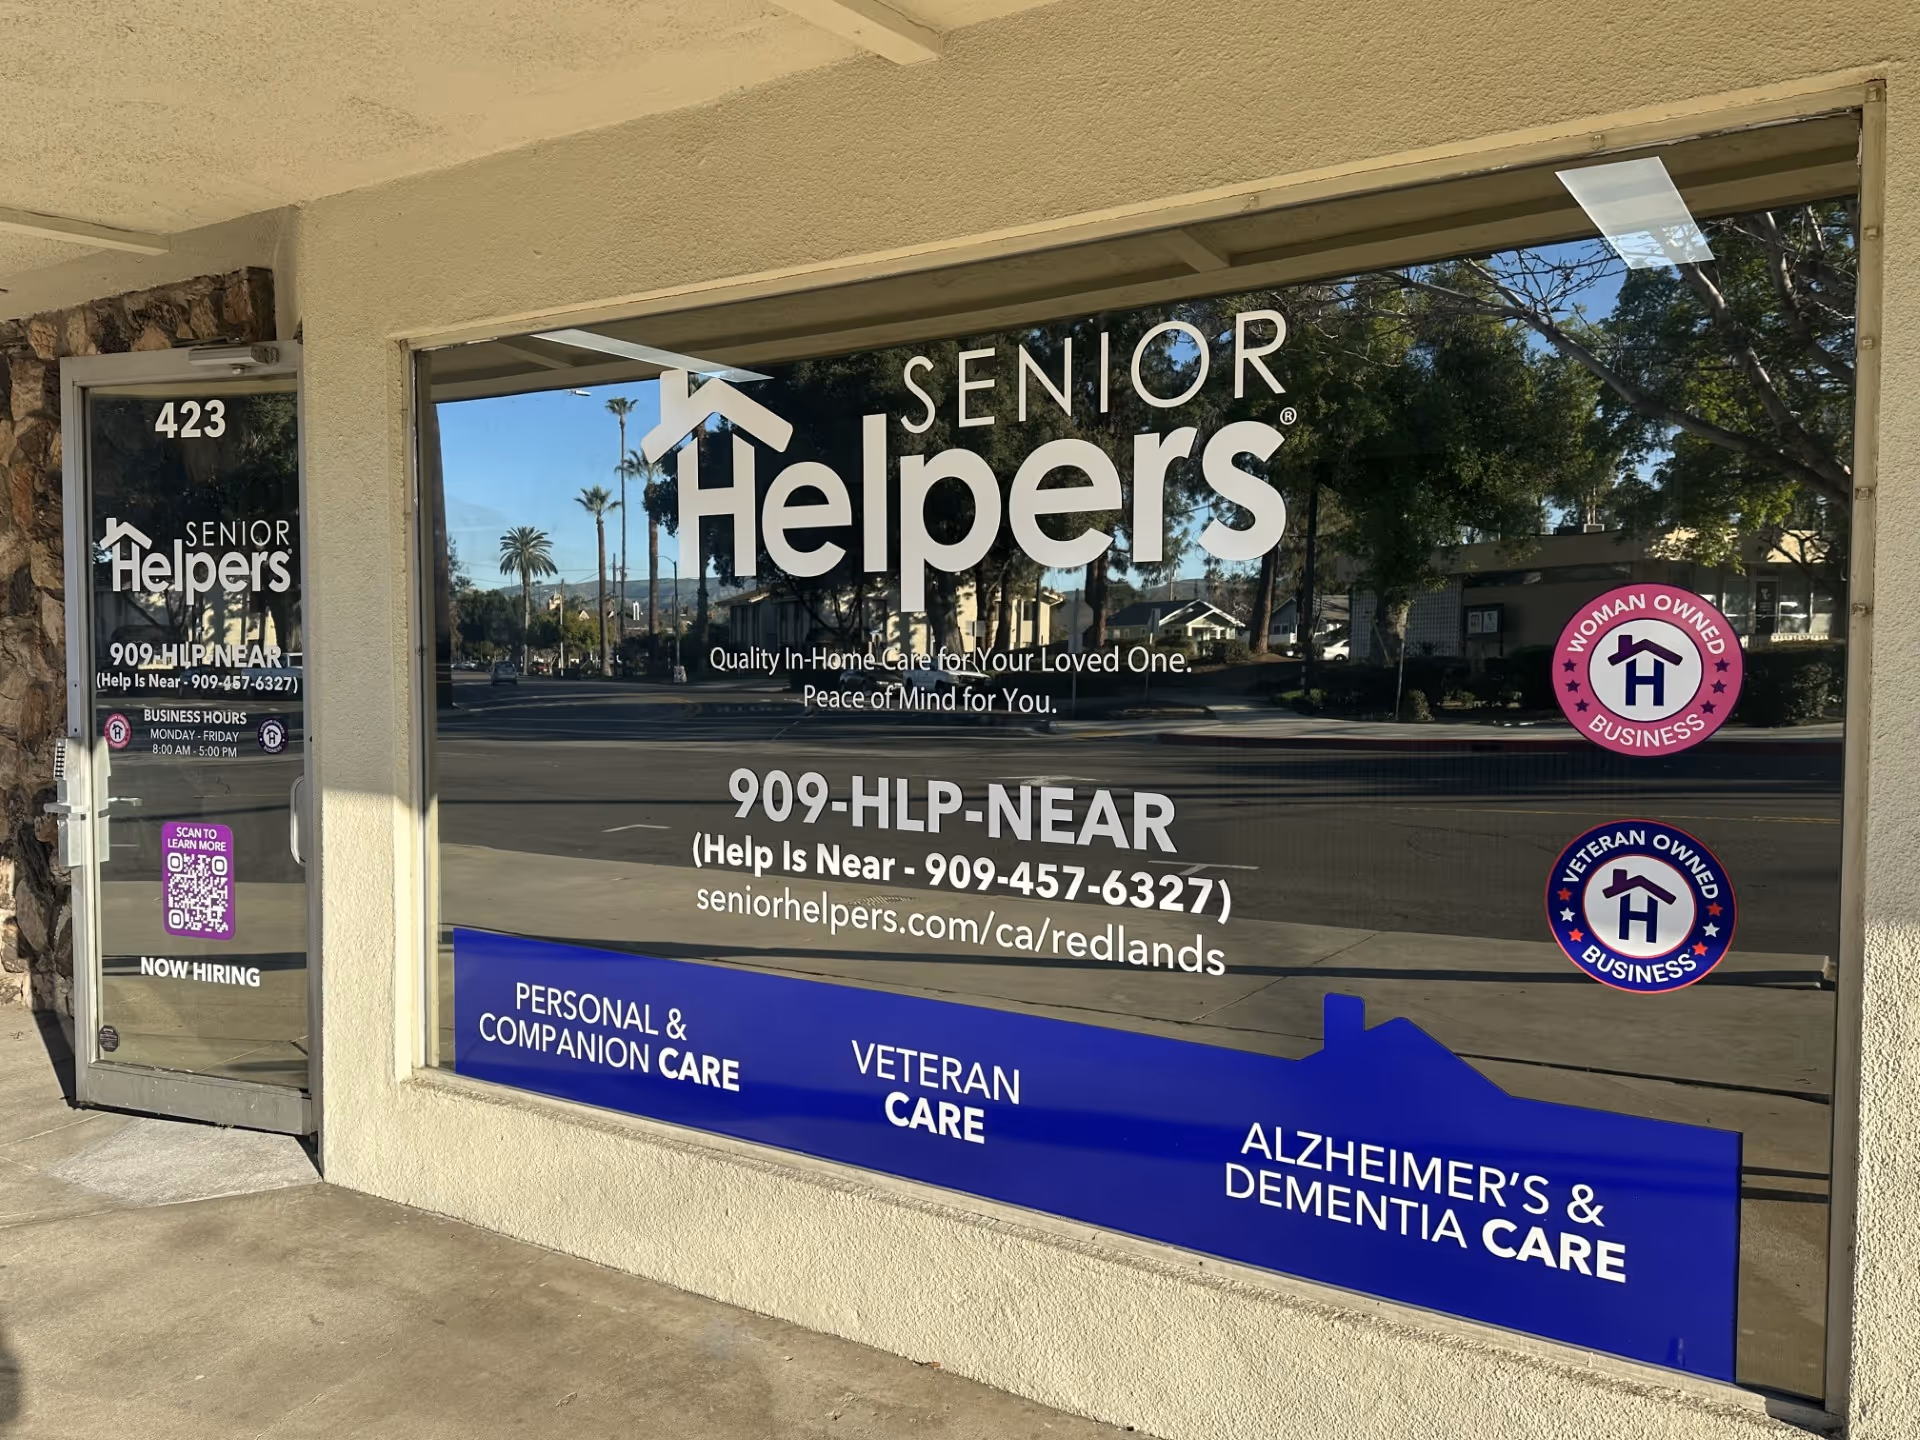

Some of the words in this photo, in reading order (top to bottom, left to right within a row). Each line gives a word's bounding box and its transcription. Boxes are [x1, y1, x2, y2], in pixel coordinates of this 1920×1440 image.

[901, 309, 1287, 434] SENIOR
[155, 399, 226, 438] 423
[185, 519, 290, 547] SENIOR
[1567, 593, 1646, 653] WOMAN
[1653, 594, 1726, 655] OWNED
[110, 642, 282, 668] 909-HLP-NEAR
[710, 646, 780, 675] Quality
[785, 647, 875, 671] In-Home
[882, 648, 932, 671] Care
[938, 646, 968, 671] for
[977, 647, 1034, 672] Your
[1041, 645, 1119, 673] Loved
[1127, 646, 1192, 673] One.
[96, 672, 131, 691] (Help
[135, 673, 145, 688] Is
[149, 674, 181, 689] Near
[191, 675, 299, 694] 909-457-6327)
[804, 684, 865, 708] Peace
[870, 685, 893, 709] of
[900, 685, 956, 711] Mind
[962, 686, 996, 712] for
[1002, 687, 1057, 714] You.
[144, 709, 200, 724] BUSINESS
[203, 711, 248, 725] HOURS
[150, 728, 195, 741] MONDAY
[203, 731, 239, 743] FRIDAY
[1588, 713, 1706, 748] BUSINESS
[152, 744, 173, 755] 8:00
[175, 745, 191, 756] AM
[199, 746, 220, 757] 5:00
[222, 747, 237, 758] PM
[728, 767, 1178, 853] 909-HLP-NEAR
[168, 838, 197, 850] LEARN
[199, 840, 227, 852] MORE
[176, 827, 202, 838] SCAN
[203, 828, 217, 840] TO
[692, 831, 773, 877] (Help
[783, 839, 807, 872] Is
[817, 842, 895, 881] Near
[925, 852, 1231, 924] 909-457-6327)
[1562, 830, 1646, 884] VETERAN
[1652, 834, 1719, 899] OWNED
[696, 885, 1226, 977] seniorhelpers.com/ca/redlands
[141, 957, 188, 980] NOW
[193, 962, 261, 988] HIRING
[1581, 944, 1697, 983] BUSINESS
[515, 981, 659, 1036] PERSONAL
[666, 1007, 687, 1041] &
[478, 1012, 650, 1074] COMPANION
[658, 1048, 740, 1092] CARE
[851, 1039, 1021, 1105] VETERAN
[884, 1091, 985, 1144] CARE
[1240, 1122, 1550, 1215] ALZHEIMER'S
[1566, 1183, 1605, 1227] &
[1226, 1162, 1468, 1248] DEMENTIA
[1481, 1218, 1627, 1283] CARE
